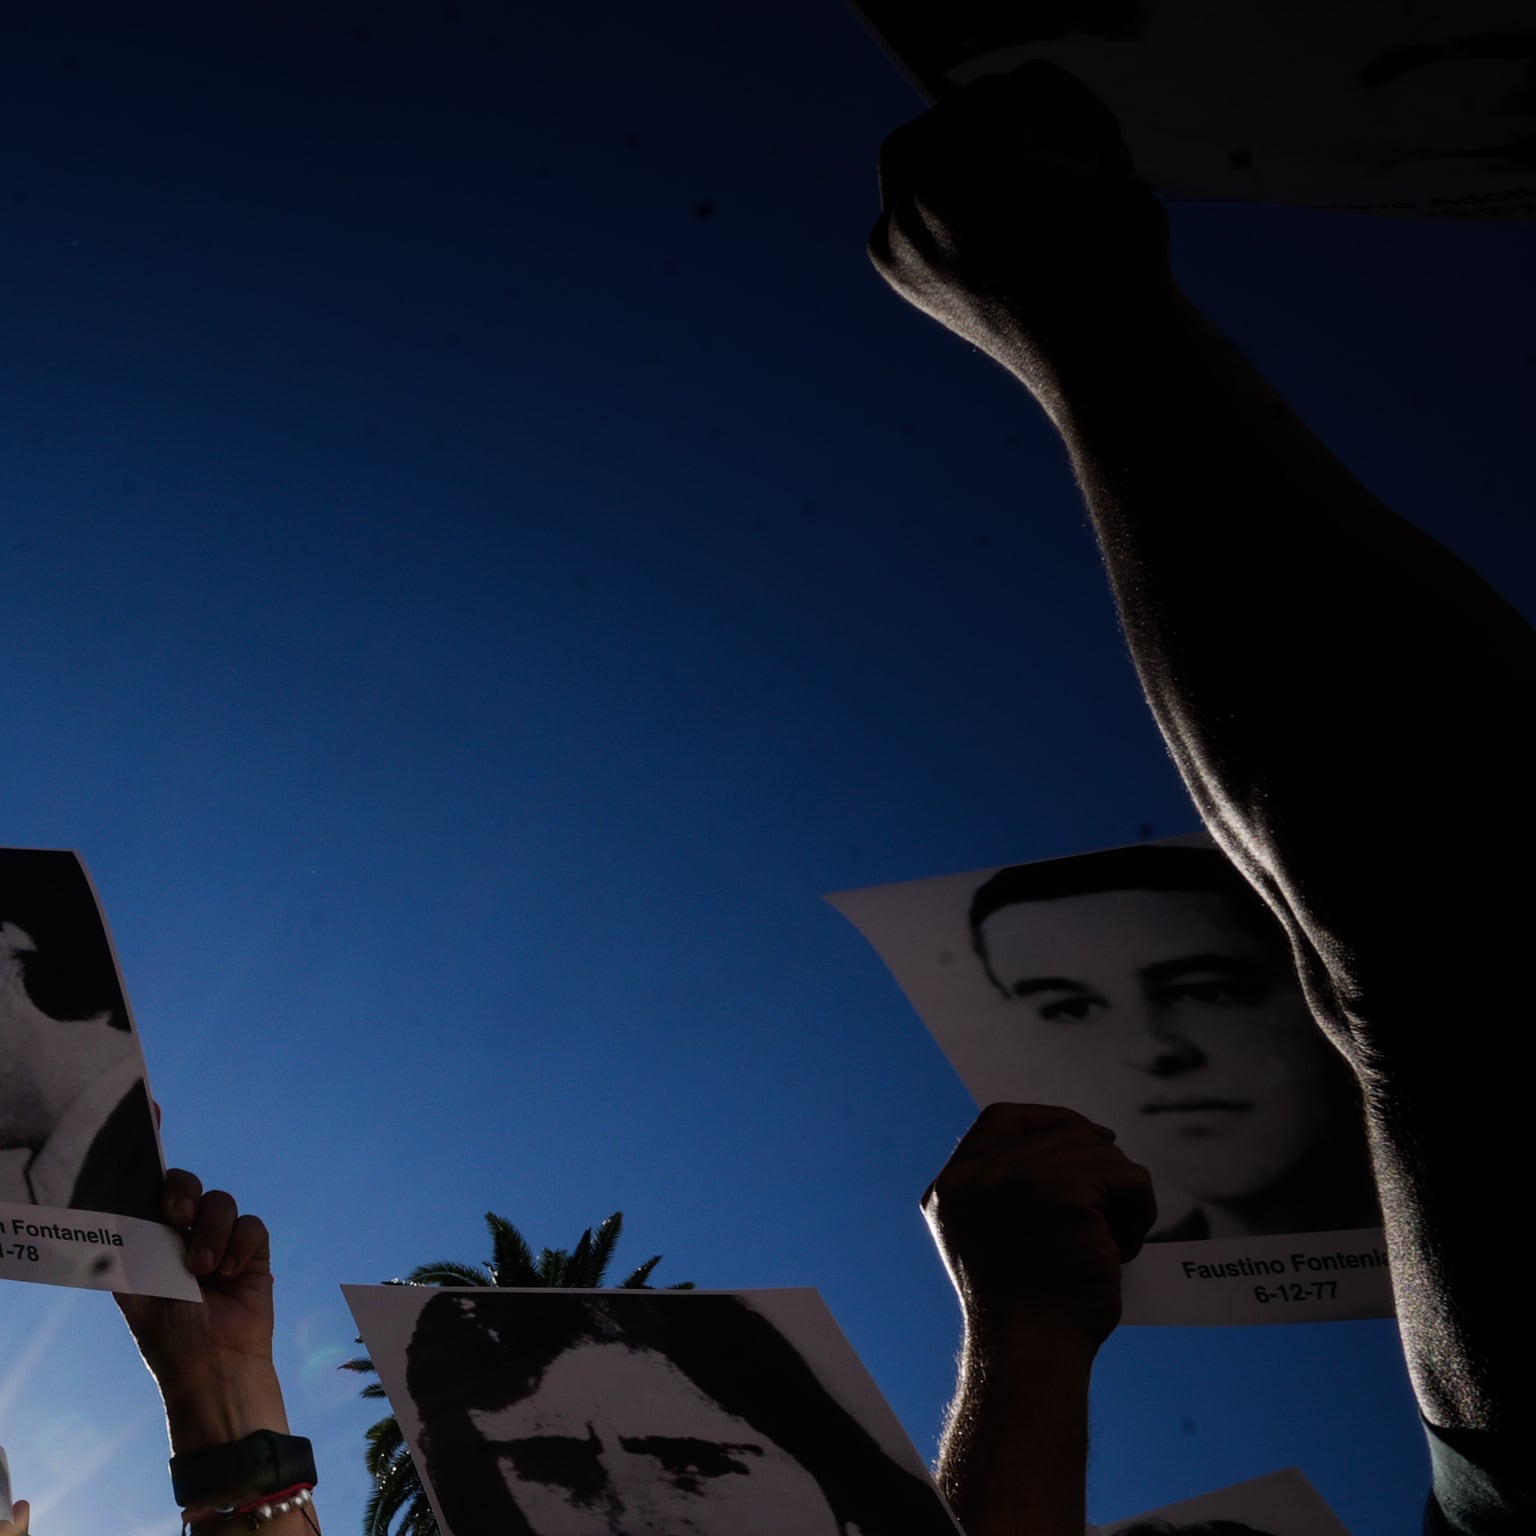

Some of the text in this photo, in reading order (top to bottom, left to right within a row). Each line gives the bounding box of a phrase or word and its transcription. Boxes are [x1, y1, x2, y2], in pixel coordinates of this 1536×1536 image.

[12, 1218, 125, 1248] Fontanella
[1181, 1257, 1286, 1280] Faustino
[1254, 1281, 1339, 1304] 6-12-77
